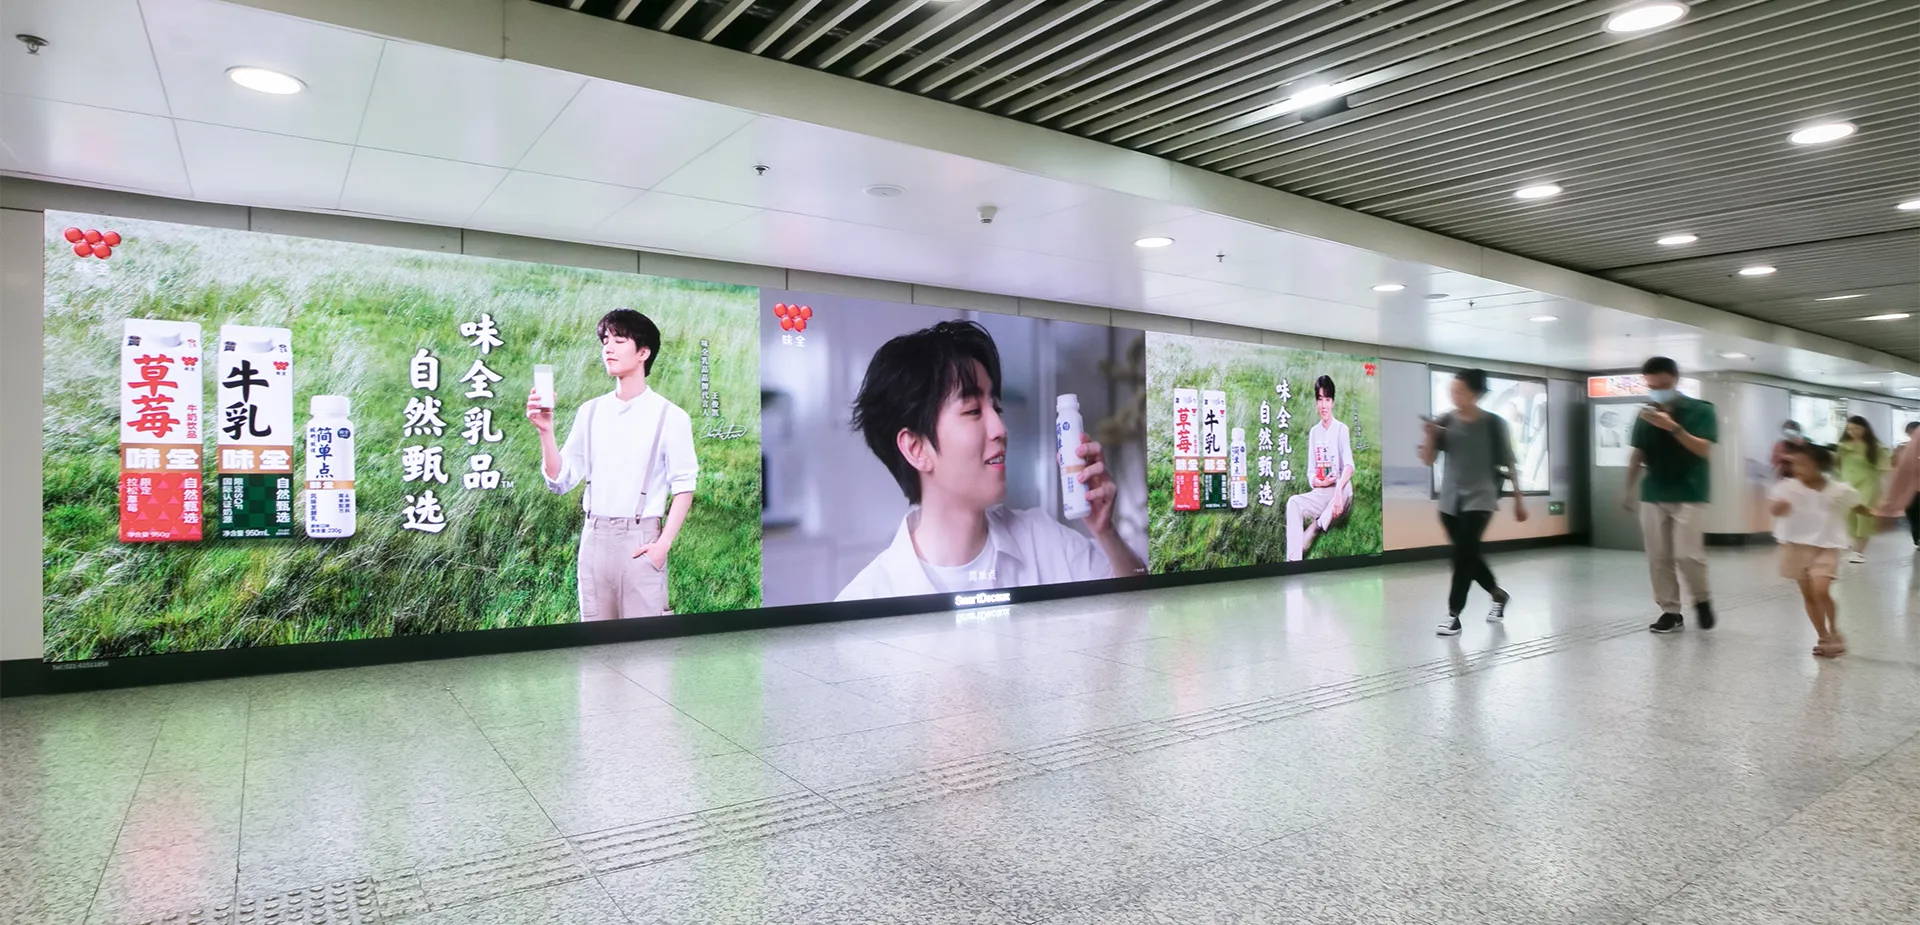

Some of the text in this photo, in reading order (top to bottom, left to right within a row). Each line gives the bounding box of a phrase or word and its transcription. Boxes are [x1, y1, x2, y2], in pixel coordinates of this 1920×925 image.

[782, 334, 806, 348] 味全
[127, 354, 180, 438] 草莓
[222, 359, 272, 441] 牛乳
[460, 313, 504, 490] 味全乳品
[187, 404, 197, 439] 牛奶饮品
[402, 348, 449, 534] 自然甄选
[1176, 407, 1192, 453] 草莓
[1204, 409, 1220, 454] 牛乳
[1276, 379, 1291, 481] 味全乳品
[125, 447, 199, 470] 味全
[222, 449, 291, 470] 味全
[315, 427, 334, 479] 简单点
[1258, 400, 1274, 506] 自然甄选
[183, 477, 199, 525] 自然甄选
[275, 477, 291, 523] 自然甄选
[501, 480, 514, 488] TM
